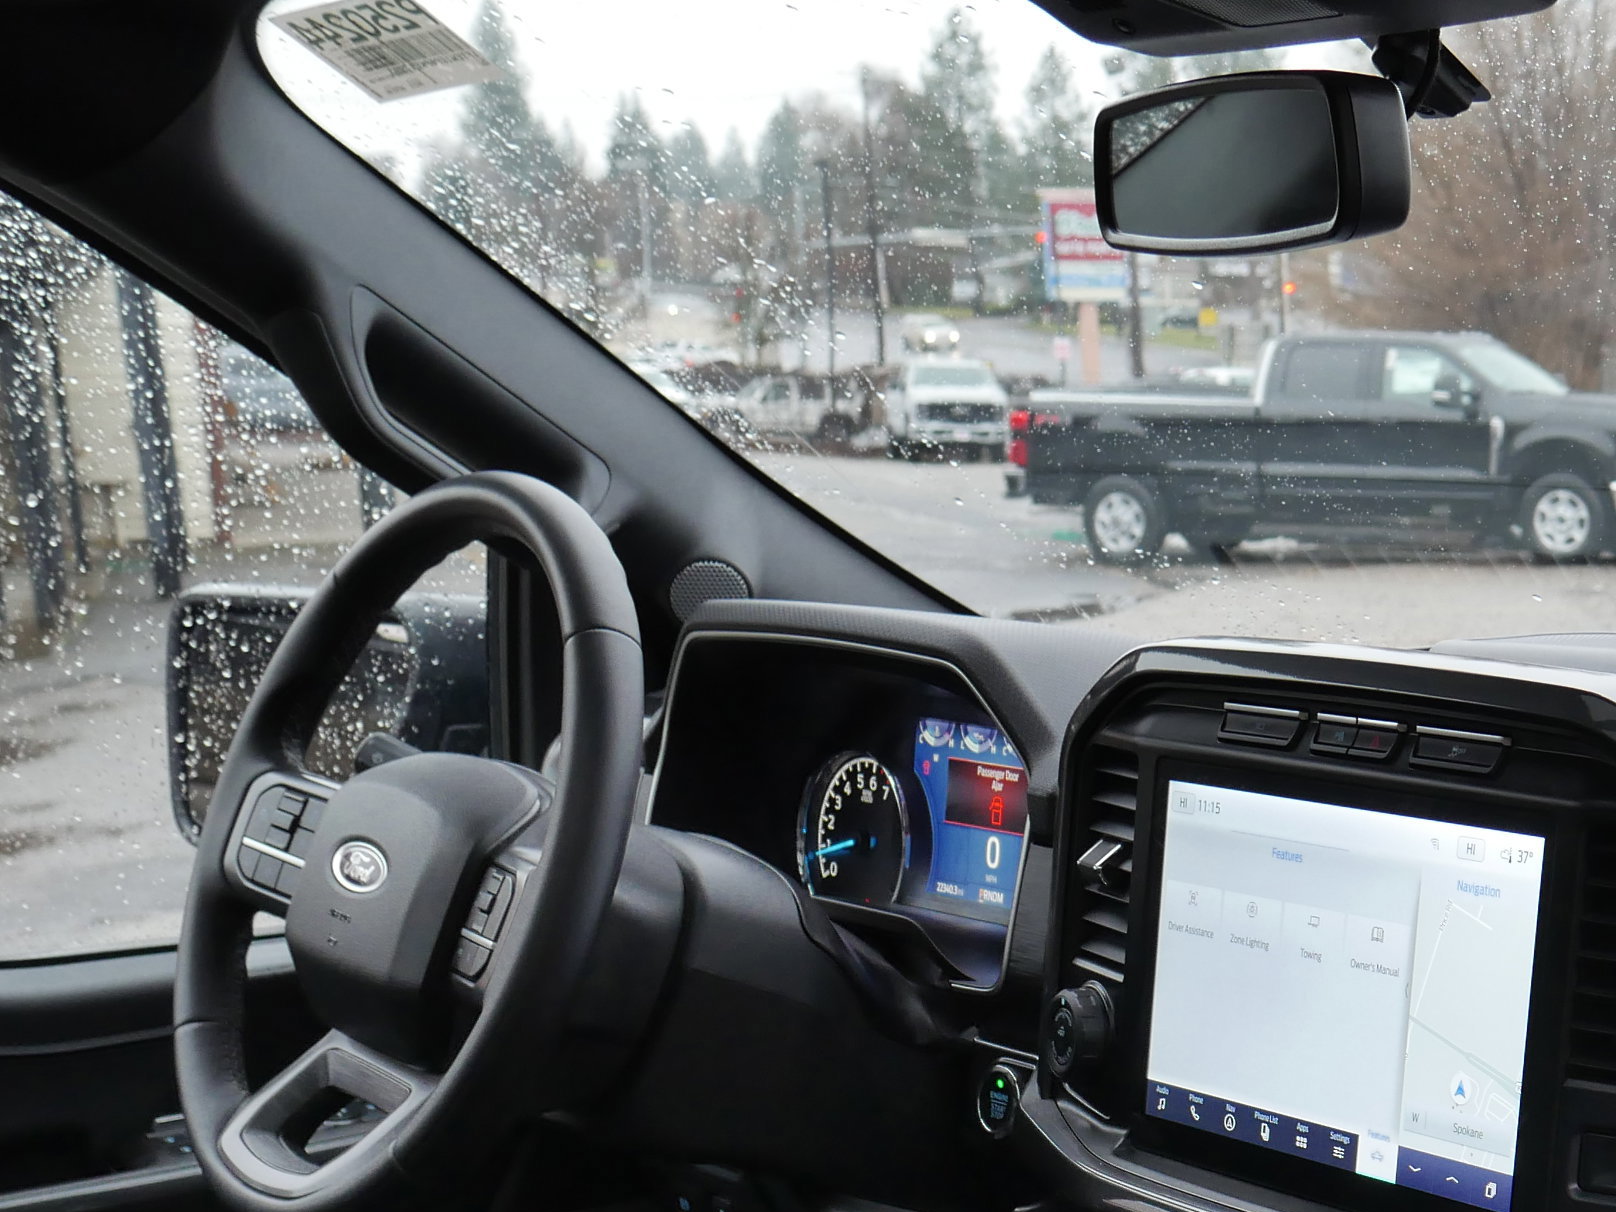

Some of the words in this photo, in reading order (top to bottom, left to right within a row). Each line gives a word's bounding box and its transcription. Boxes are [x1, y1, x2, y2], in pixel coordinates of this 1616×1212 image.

[856, 773, 865, 789] 5
[977, 766, 1005, 780] Passenger
[1005, 770, 1019, 783] Door
[843, 781, 851, 796] 4
[869, 776, 877, 791] 6
[881, 785, 890, 800] 7
[833, 795, 842, 810] 3
[1197, 799, 1221, 814] 11:15
[827, 814, 835, 830] 2
[986, 835, 1001, 870] 0
[1271, 847, 1304, 863] Features
[1466, 842, 1477, 856] HI
[830, 861, 839, 877] 0
[1456, 879, 1502, 899] Navigation
[1300, 947, 1323, 963] Towing
[1350, 958, 1376, 973] Owner's
[1376, 963, 1400, 977] Manual
[1411, 1111, 1420, 1123] W
[1329, 1131, 1351, 1145] Settings
[1453, 1122, 1484, 1140] Spokane
